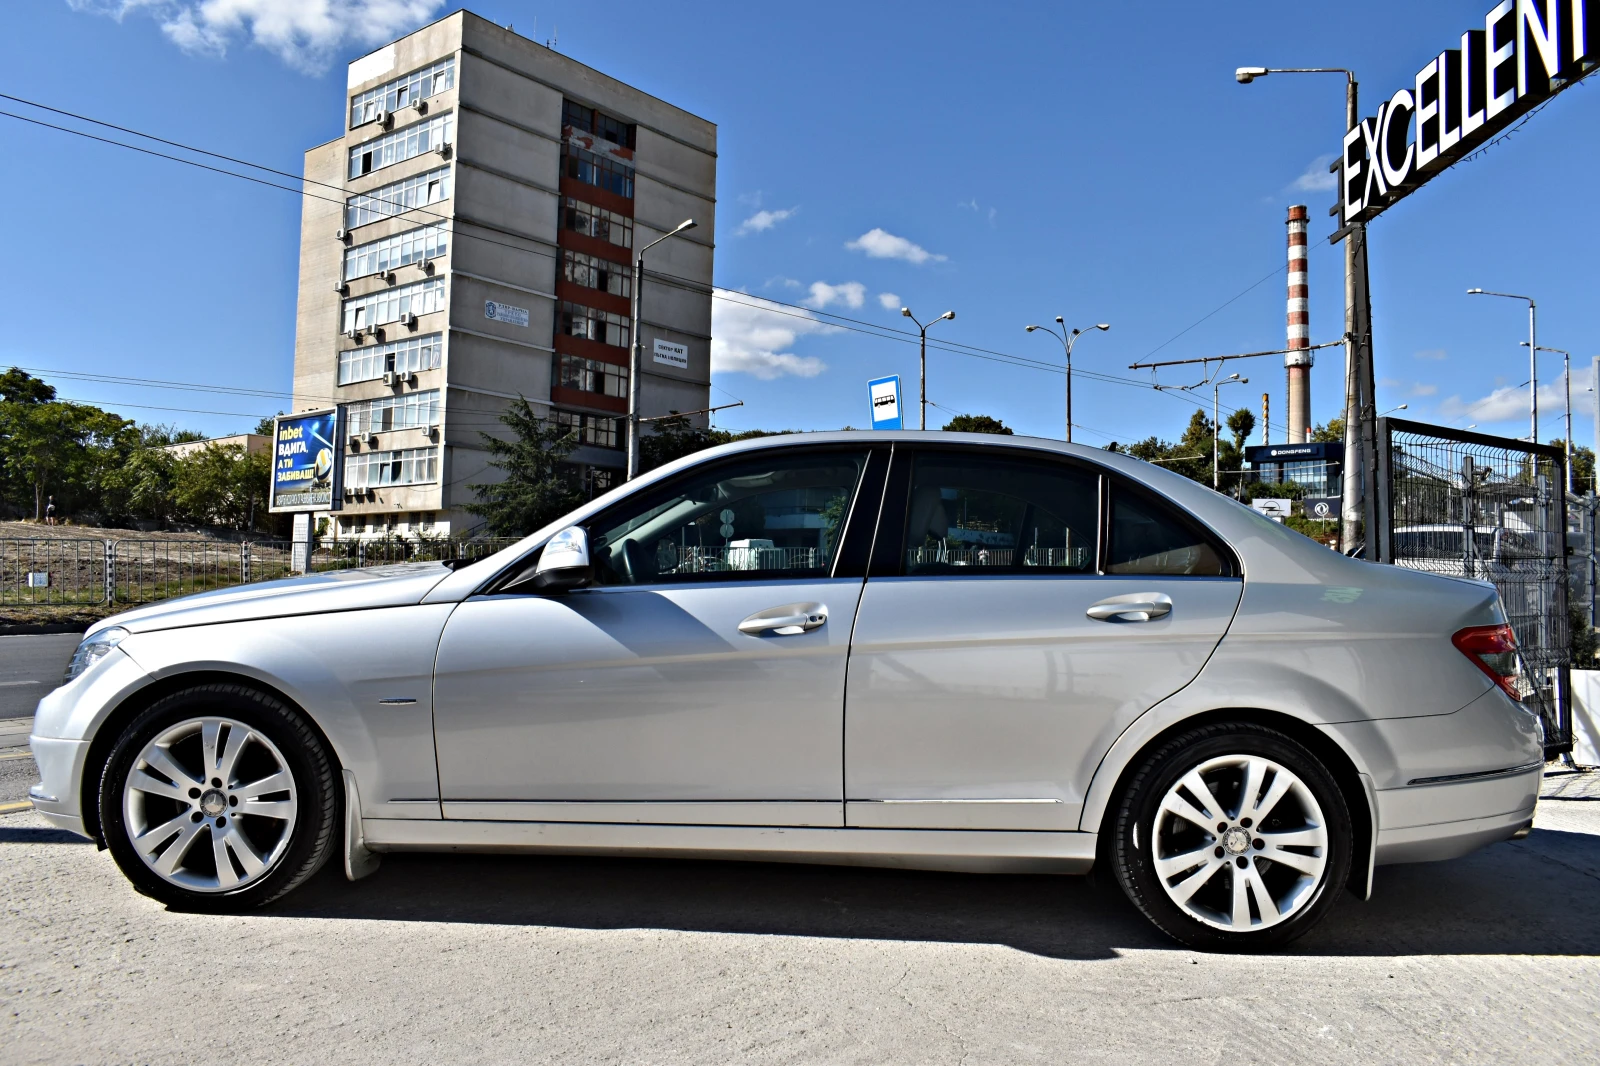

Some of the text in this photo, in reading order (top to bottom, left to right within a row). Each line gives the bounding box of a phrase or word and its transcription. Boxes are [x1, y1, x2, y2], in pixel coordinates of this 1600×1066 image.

[279, 425, 303, 441] inbet
[278, 441, 309, 457] ВДИГА,
[278, 458, 293, 469] А ТИ
[277, 468, 314, 482] ЗАБИВАШ!
